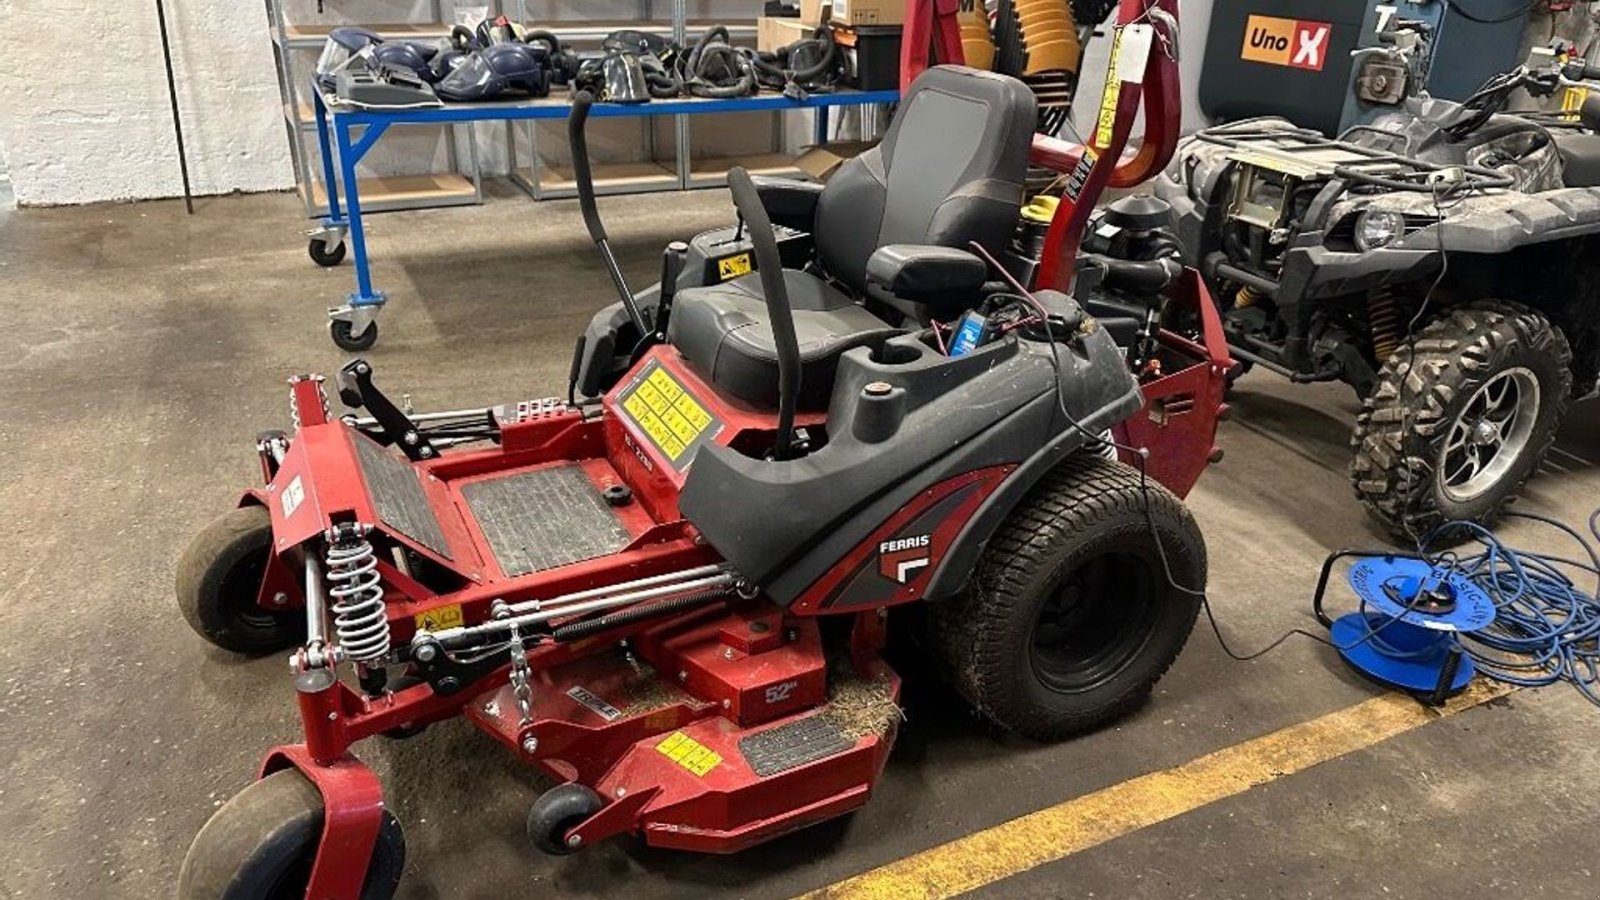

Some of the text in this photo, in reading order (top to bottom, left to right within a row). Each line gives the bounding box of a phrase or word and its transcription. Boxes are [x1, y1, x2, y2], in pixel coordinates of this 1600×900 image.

[1250, 26, 1328, 66] Uno X
[880, 534, 931, 554] FERRIS
[1431, 568, 1489, 626] BSIC-LINE
[569, 688, 619, 717] TRLE
